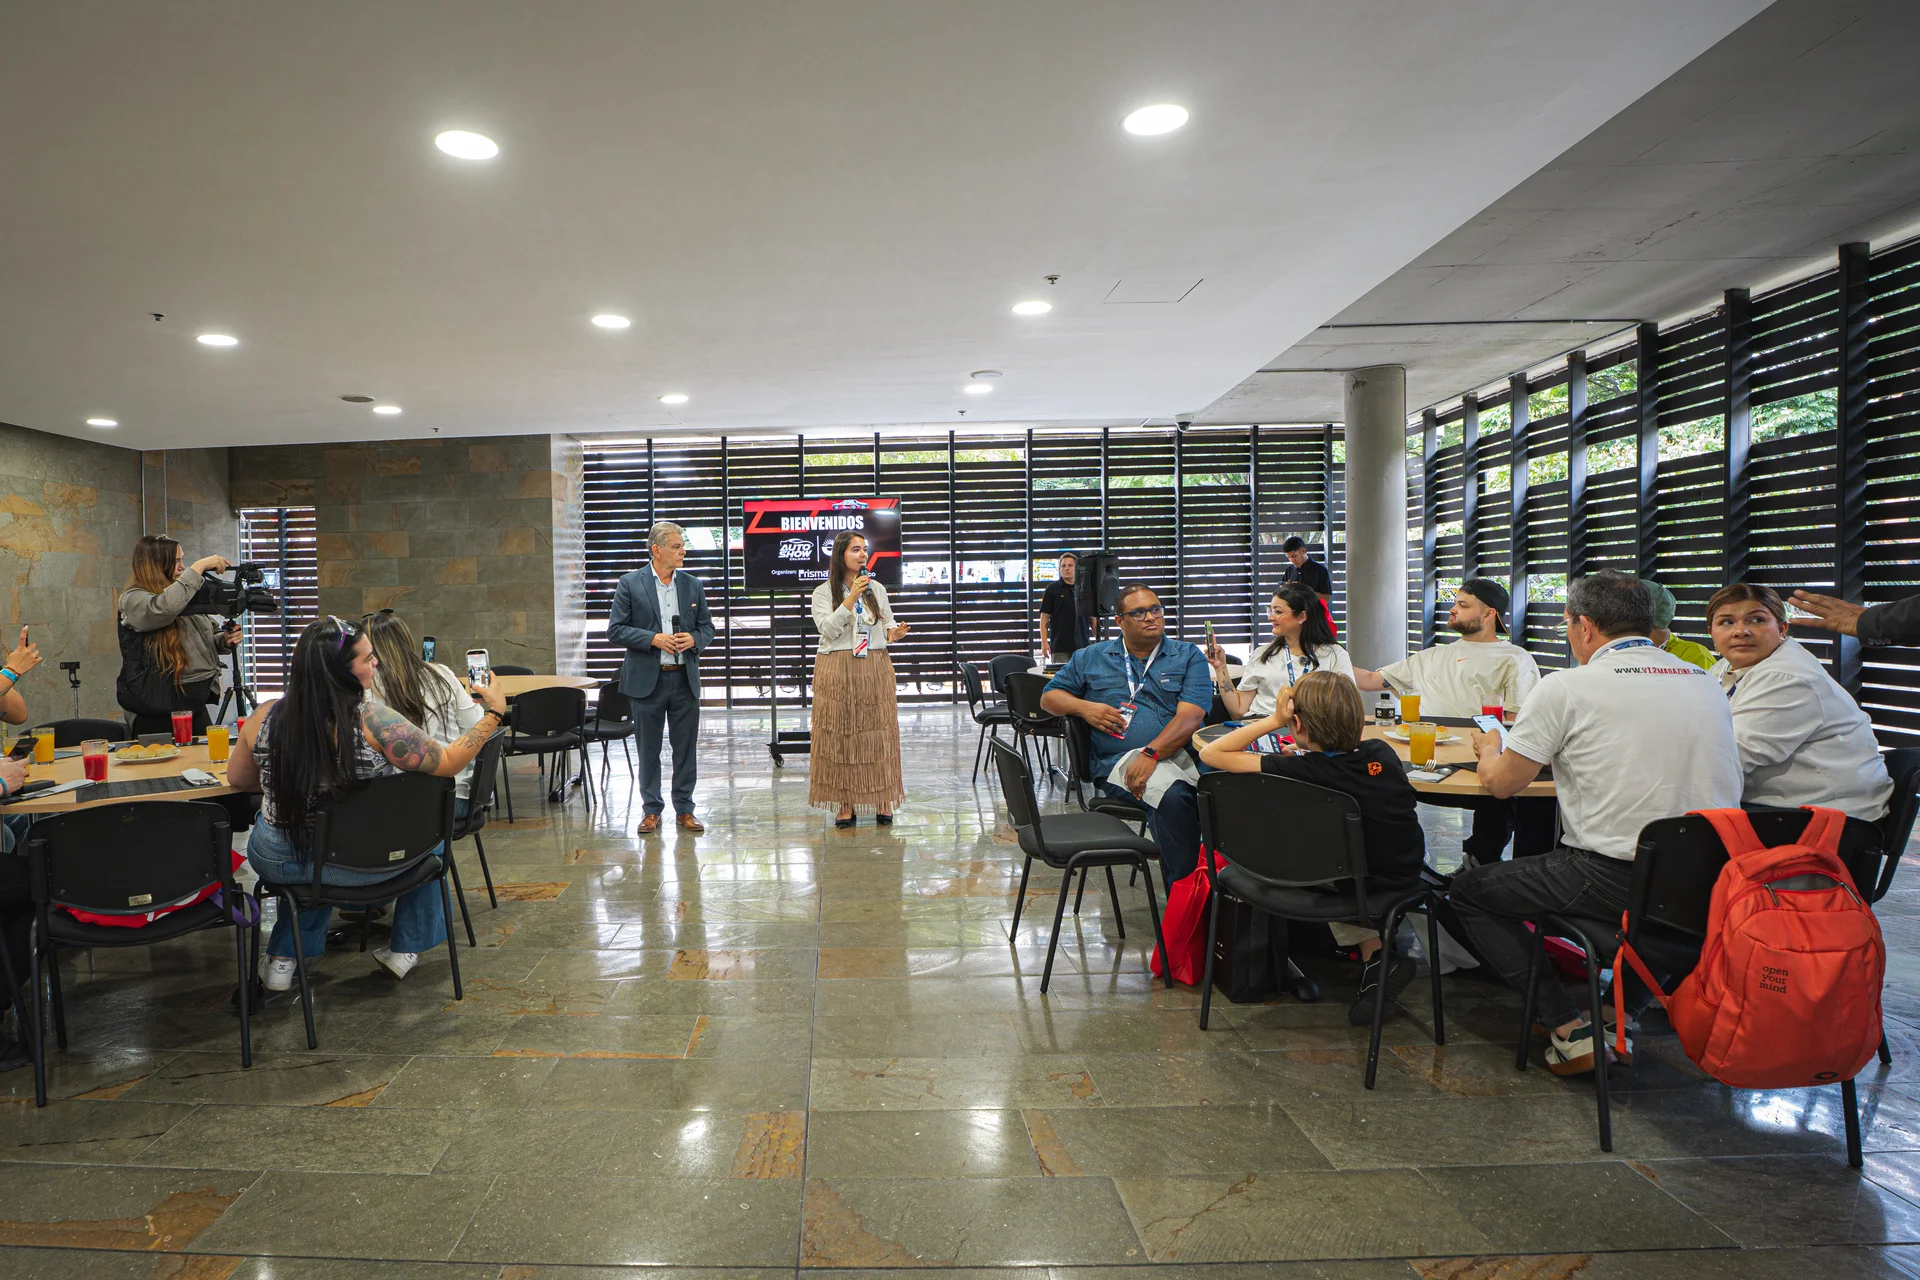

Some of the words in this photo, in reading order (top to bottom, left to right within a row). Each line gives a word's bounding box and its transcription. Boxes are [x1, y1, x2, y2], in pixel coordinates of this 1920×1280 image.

[781, 515, 864, 531] BIENVENIDOS
[780, 543, 811, 551] AUTO
[778, 550, 812, 559] SHOW
[798, 569, 829, 578] Prisma
[1762, 966, 1788, 976] open
[1762, 974, 1787, 984] your
[1759, 982, 1786, 993] mind
